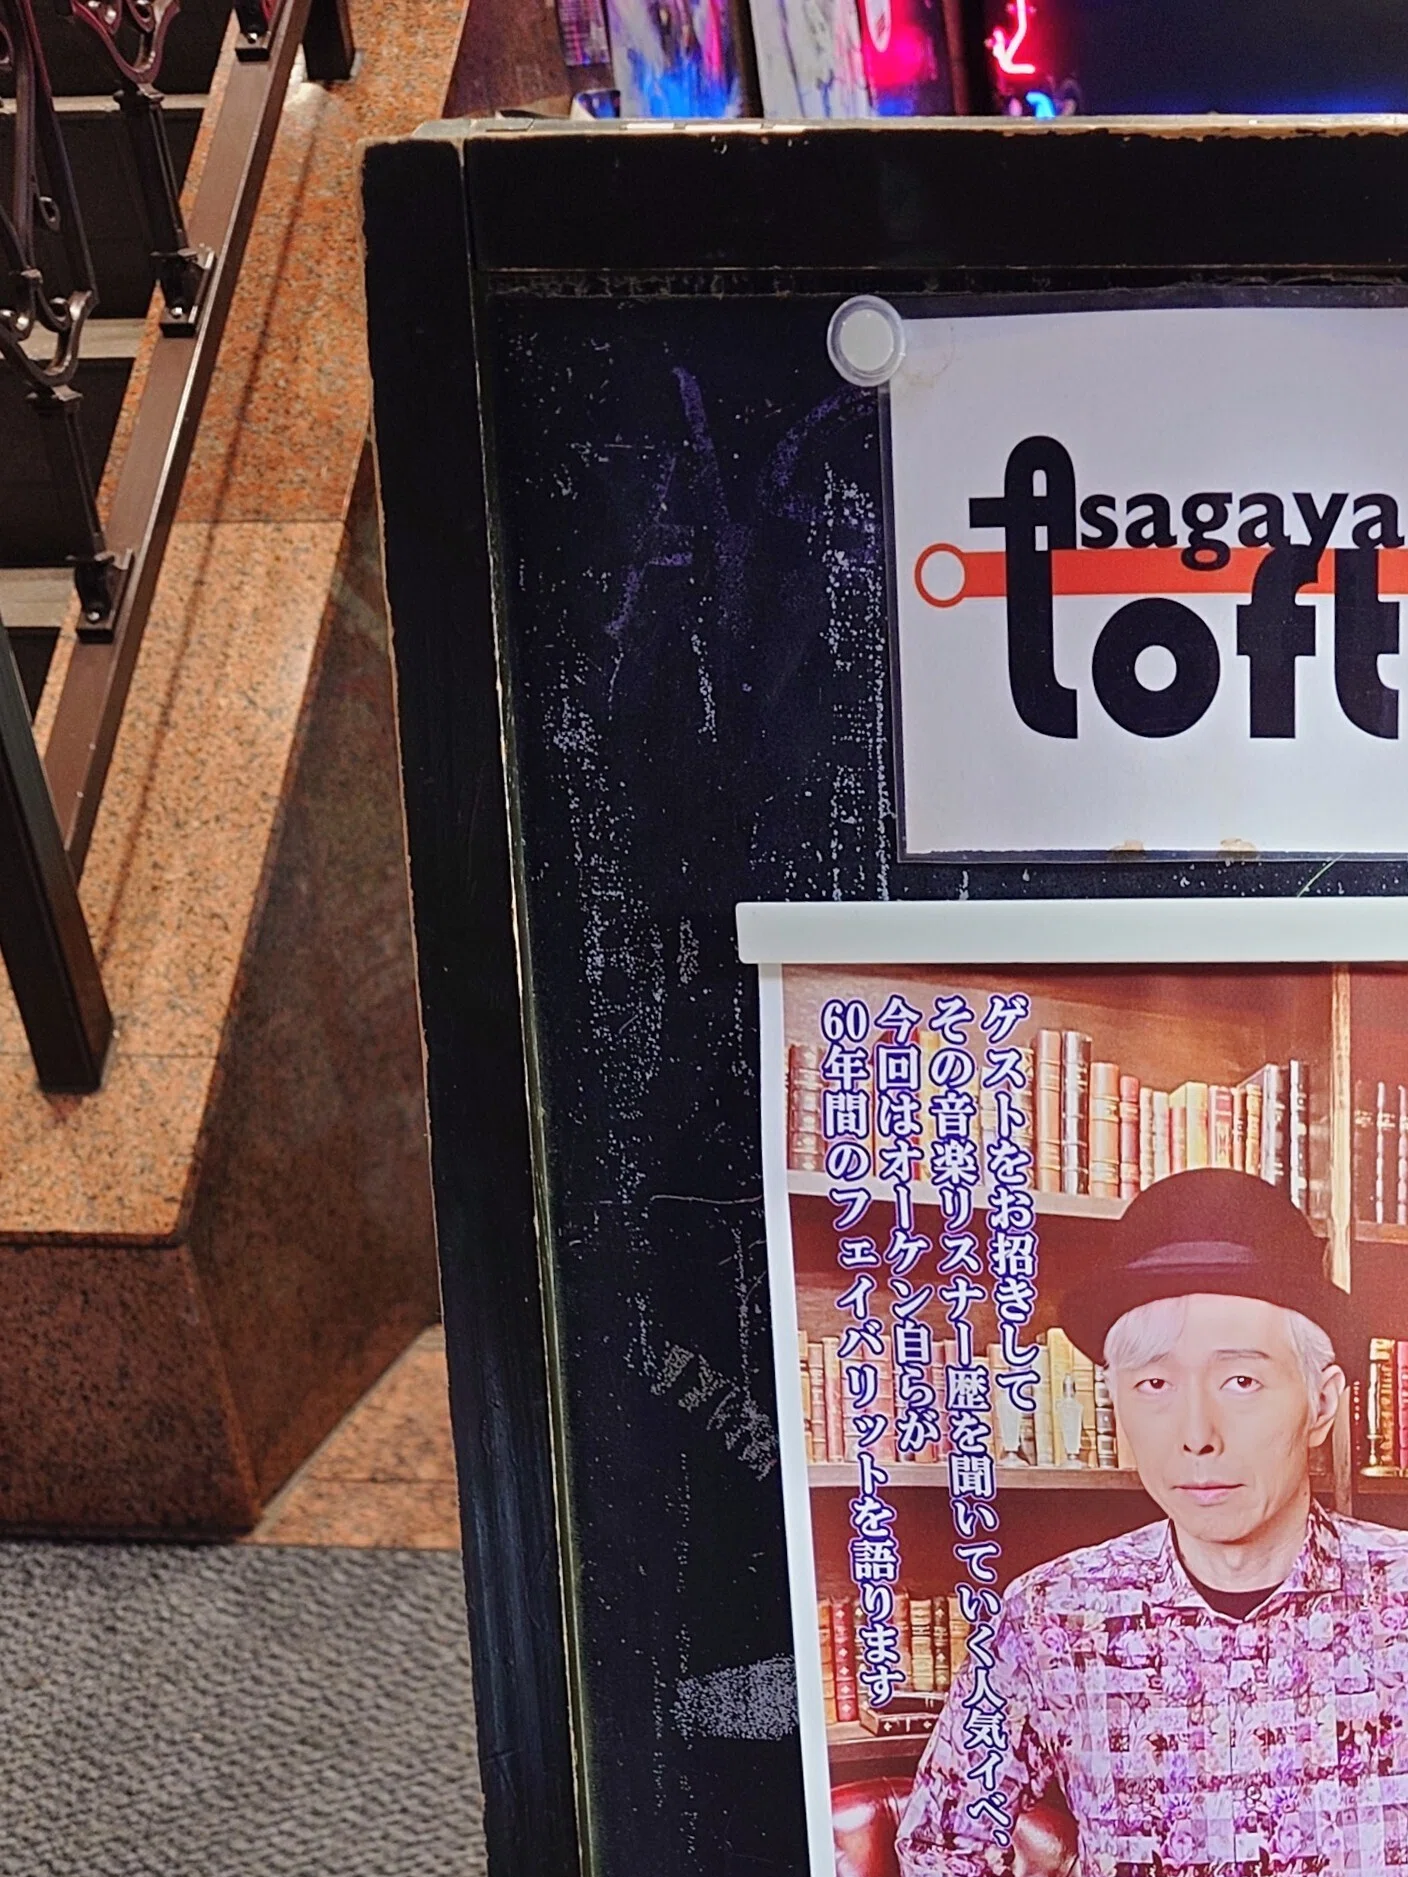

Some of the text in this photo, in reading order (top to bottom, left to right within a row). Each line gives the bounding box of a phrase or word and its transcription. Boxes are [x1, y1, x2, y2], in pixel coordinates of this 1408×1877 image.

[969, 435, 1405, 570] Asagaya
[820, 998, 904, 1708] 60年間のフェイバリットを語ります
[874, 994, 939, 1453] 今回はオーケン自らが
[980, 994, 1040, 1412] ゲストをお招きして
